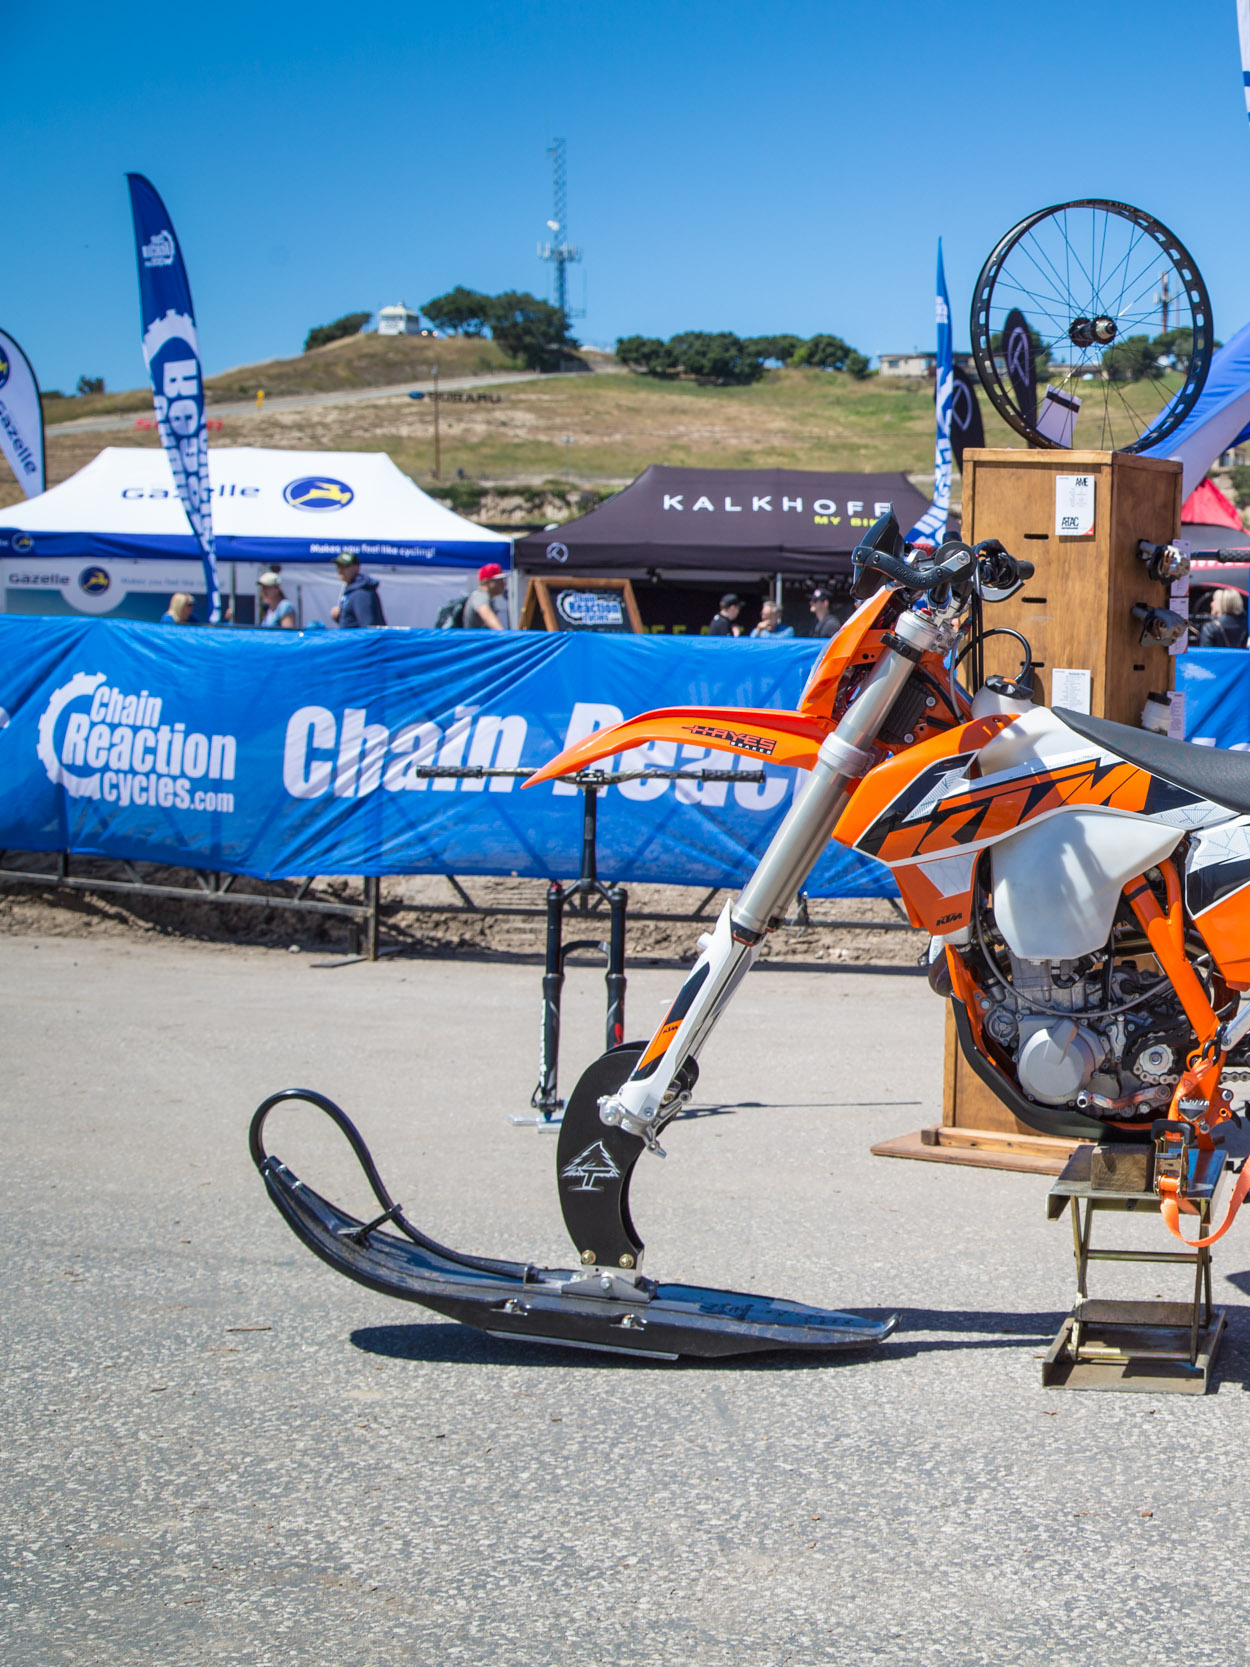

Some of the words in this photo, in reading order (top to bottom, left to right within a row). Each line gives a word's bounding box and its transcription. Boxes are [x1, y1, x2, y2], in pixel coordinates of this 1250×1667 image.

[121, 484, 260, 499] Galle
[662, 494, 893, 517] KALKHOFF
[814, 515, 841, 525] MY
[361, 543, 380, 554] feel
[381, 544, 398, 555] like
[9, 572, 71, 585] Gazelle
[90, 684, 163, 728] Chain
[62, 712, 237, 781] Reaction
[688, 725, 777, 751] HAYES
[730, 741, 772, 755] BRAKES
[282, 704, 529, 800] Chain
[102, 772, 235, 814] cycles.com
[876, 759, 1152, 861] KTM
[936, 911, 962, 926] KTM
